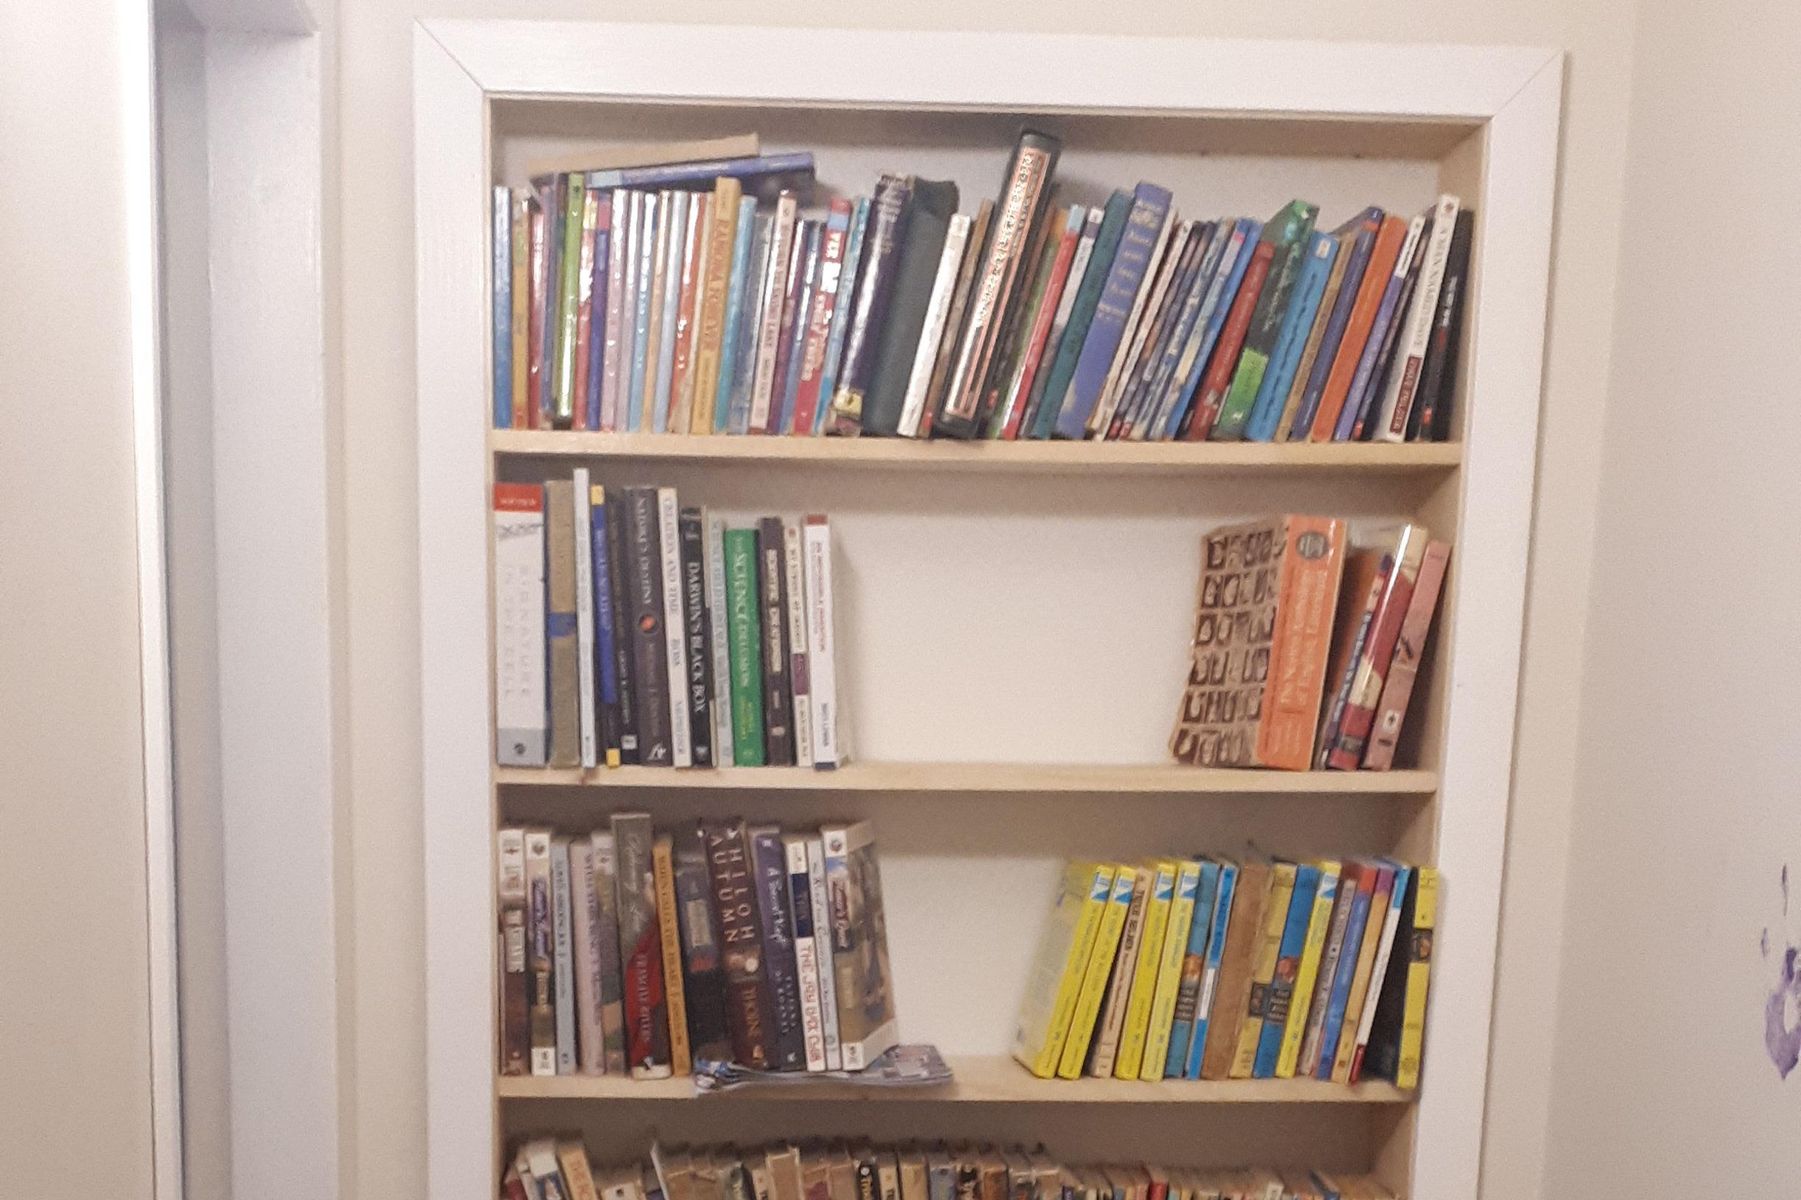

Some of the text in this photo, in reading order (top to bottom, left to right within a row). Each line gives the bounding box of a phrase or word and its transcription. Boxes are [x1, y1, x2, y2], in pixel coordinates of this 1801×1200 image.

[733, 552, 750, 623] SCIENCE
[686, 561, 707, 713] DARWIN'S BLACK BOX
[708, 832, 740, 944] AUTUMN
[798, 945, 813, 972] THE
